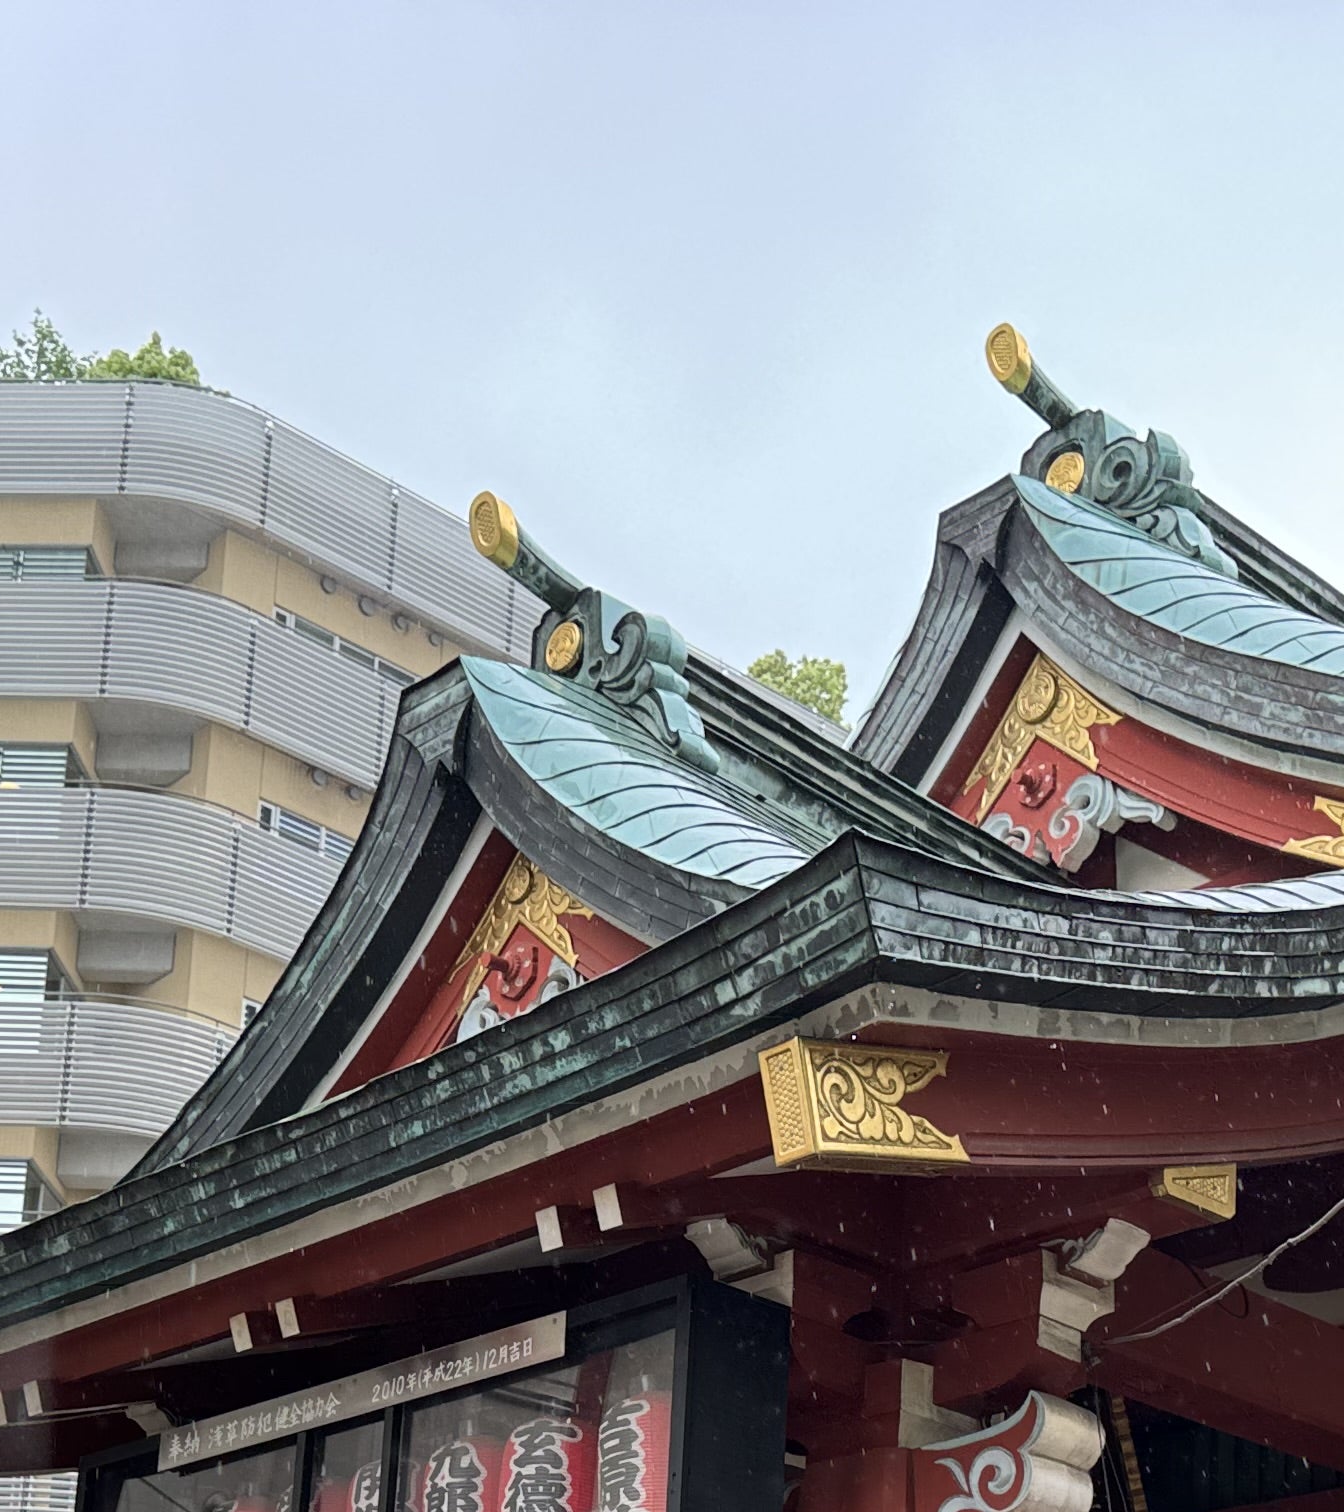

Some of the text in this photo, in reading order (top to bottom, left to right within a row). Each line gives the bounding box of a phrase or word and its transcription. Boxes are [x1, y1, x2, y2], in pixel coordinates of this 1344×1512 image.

[167, 1431, 200, 1462] 奉納
[208, 1391, 342, 1449] 浅草防犯健全協力会
